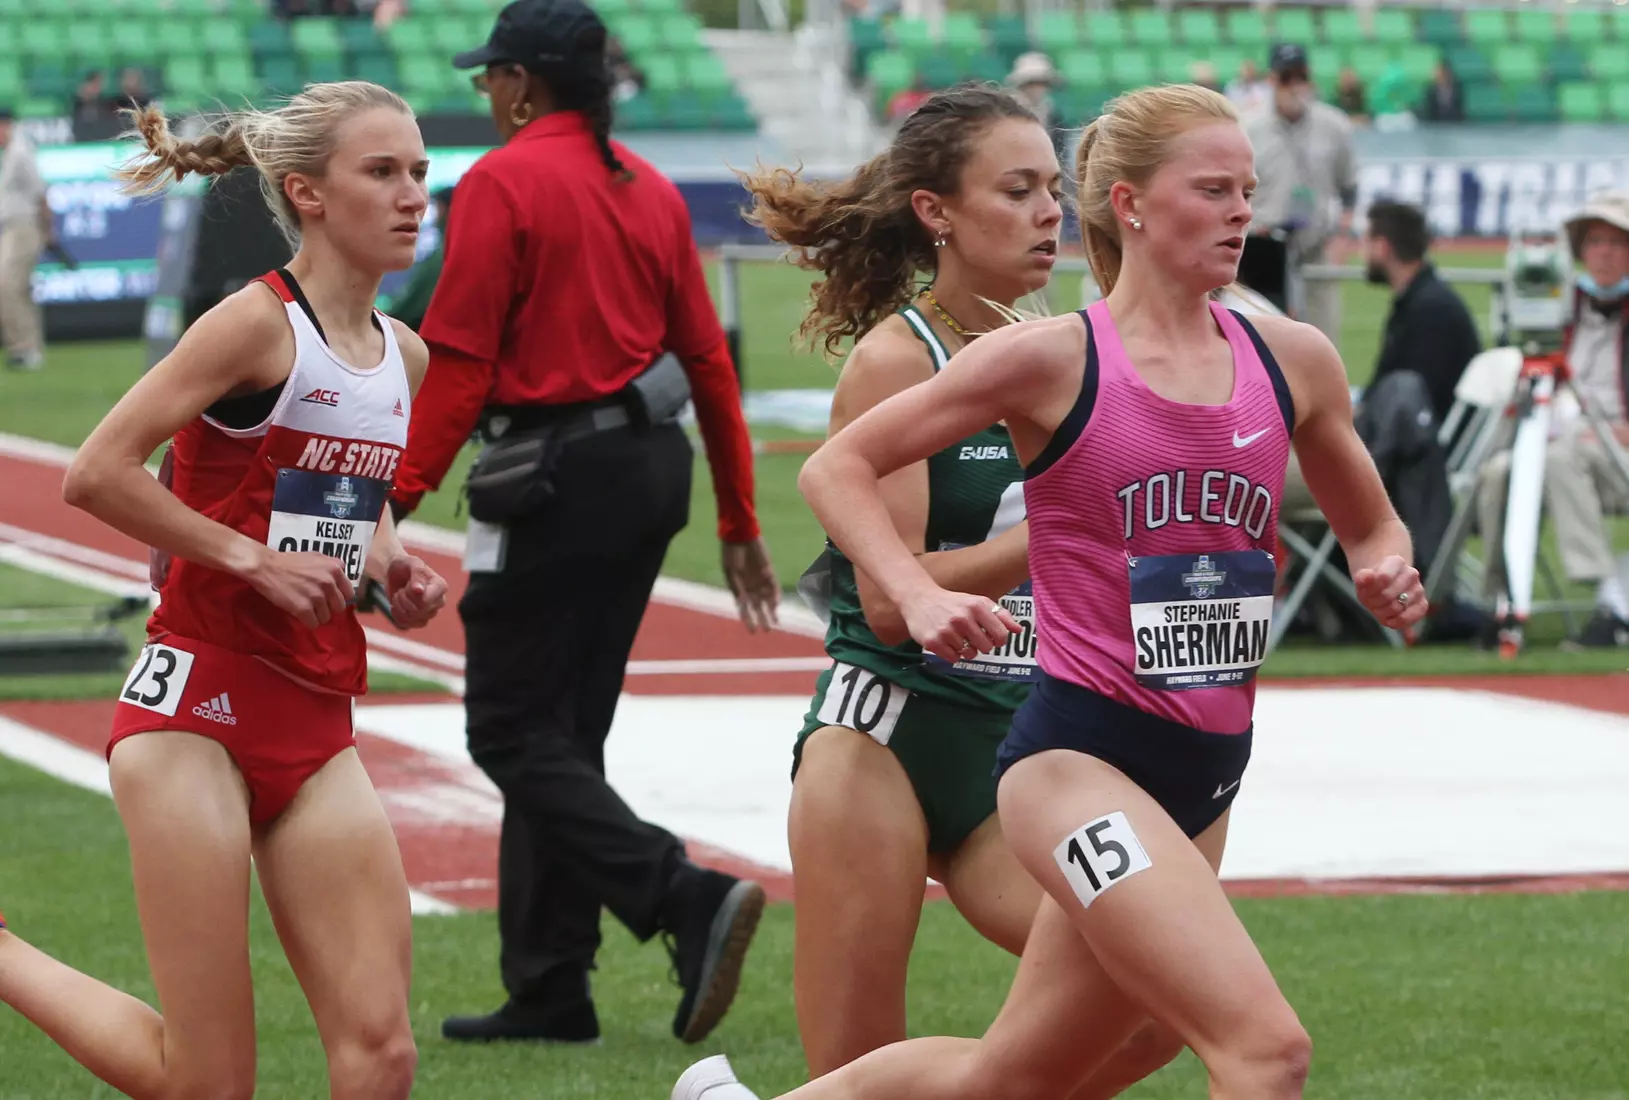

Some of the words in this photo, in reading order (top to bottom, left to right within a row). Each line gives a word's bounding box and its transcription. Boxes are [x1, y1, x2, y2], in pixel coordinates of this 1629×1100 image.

[302, 387, 340, 406] ACC
[297, 438, 341, 472] NC
[340, 444, 400, 480] STATE
[1116, 468, 1272, 541] TOLEDO
[316, 520, 355, 541] KELSEY
[1164, 602, 1241, 623] STEPHANIE
[1137, 619, 1269, 670] SHERMAN
[124, 643, 177, 707] 23
[1216, 672, 1232, 682] JUNE
[192, 706, 237, 726] adidas
[835, 667, 892, 733] 10
[1067, 819, 1131, 892] 15
